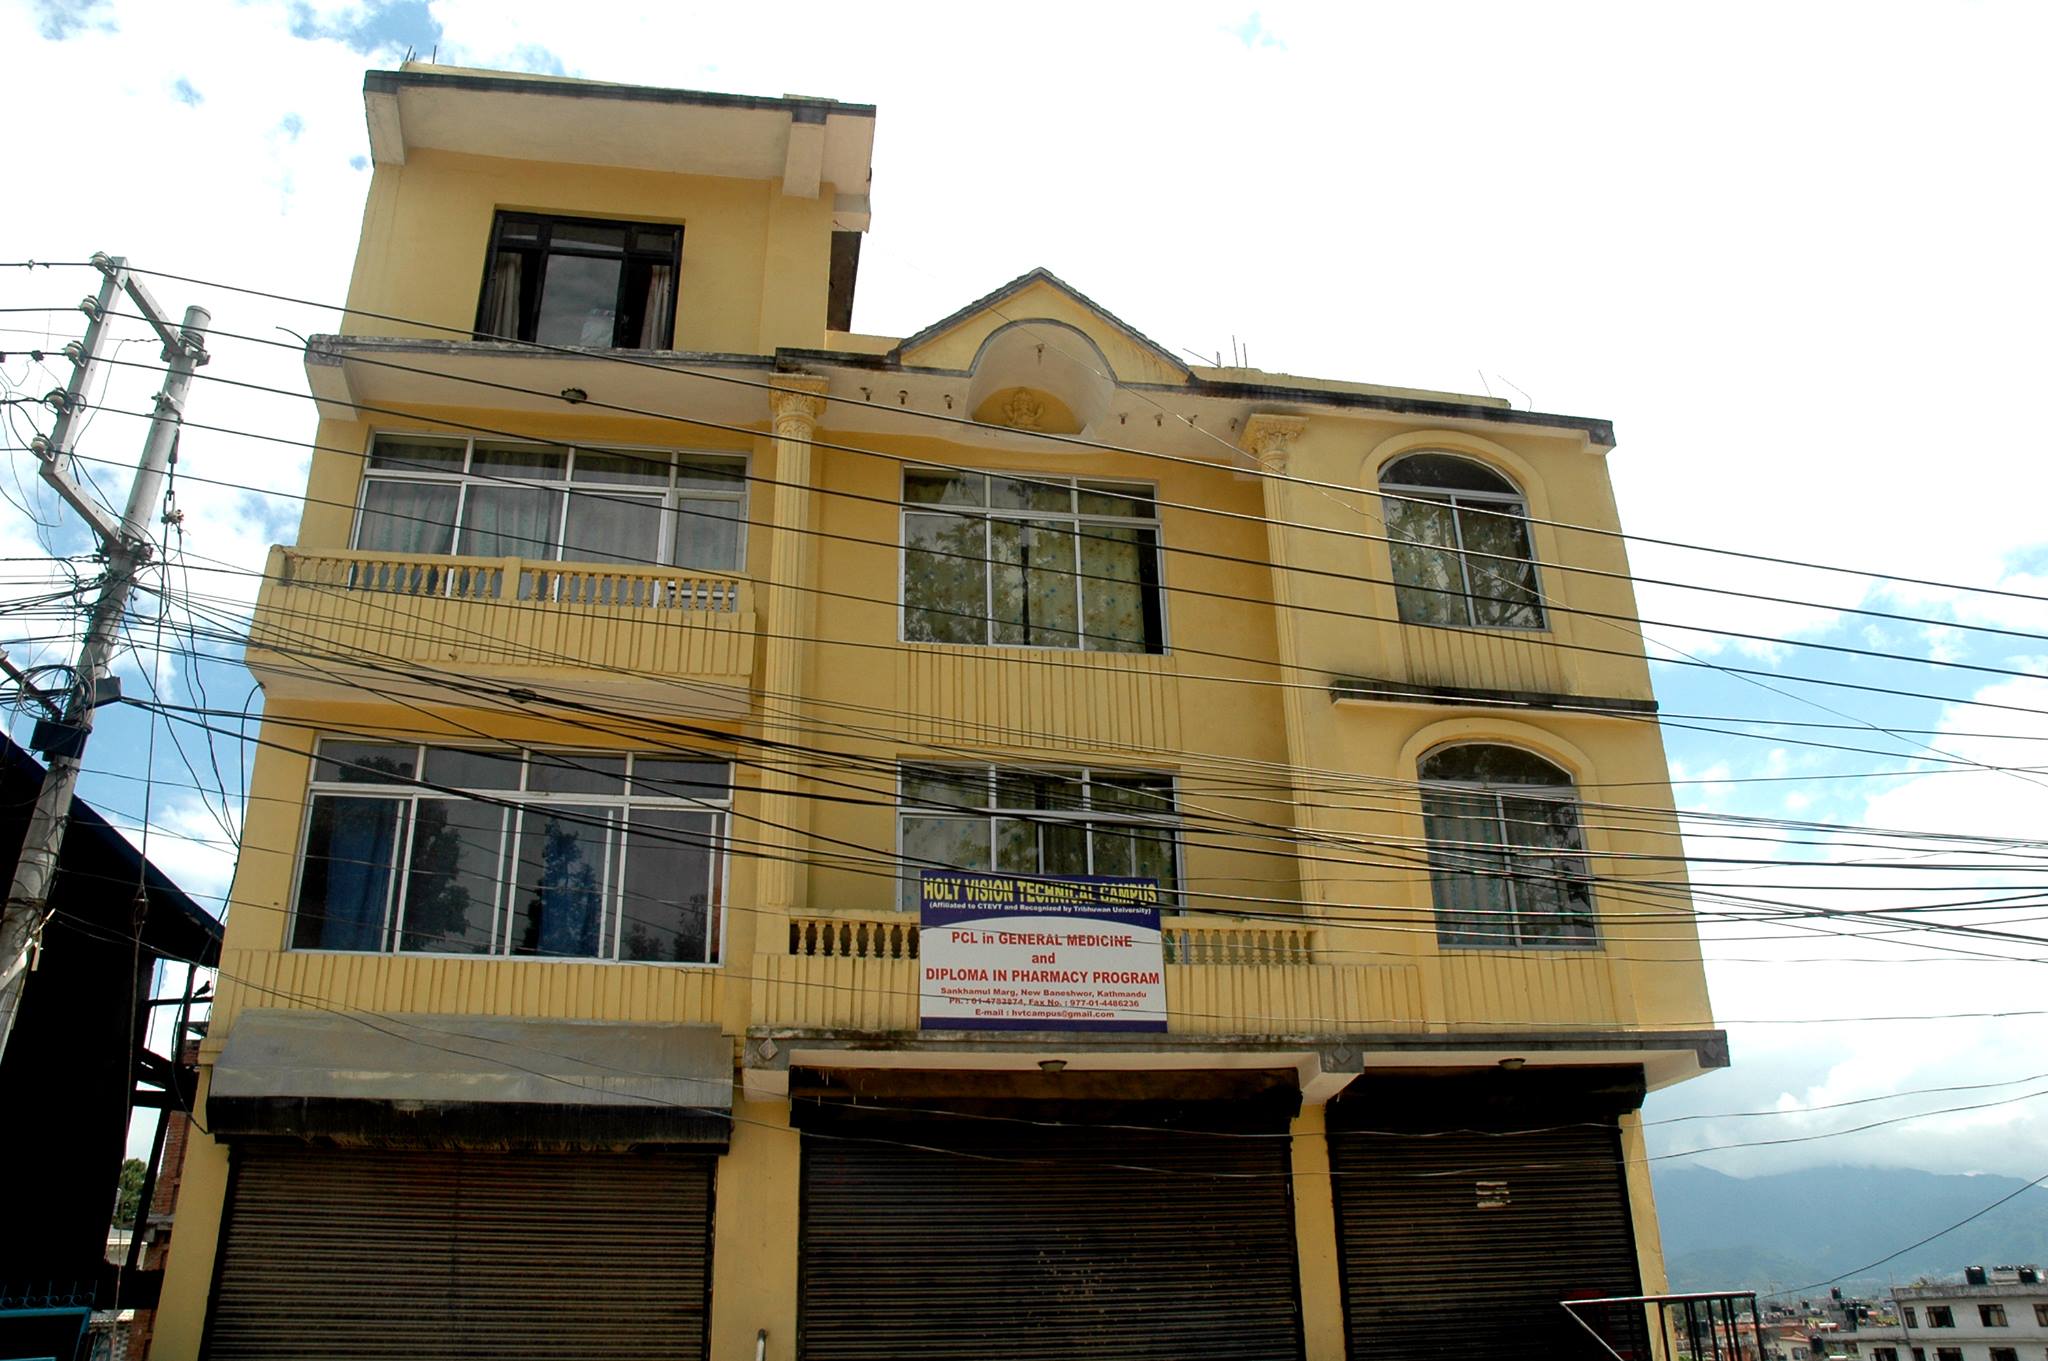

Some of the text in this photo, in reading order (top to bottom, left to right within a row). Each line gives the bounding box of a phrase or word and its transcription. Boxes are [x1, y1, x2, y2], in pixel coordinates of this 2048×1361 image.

[924, 878, 1157, 905] HOLY VISION TECHNICAL CAMPUS
[929, 901, 966, 910] (Affiliated
[1063, 905, 1072, 913] by
[1112, 906, 1152, 914] University)
[952, 932, 1132, 948] PCL in GENERAL MEDICINE
[1032, 952, 1056, 964] and
[926, 968, 1160, 984] DIPLOMA IN PHARMACY PROGRAM
[940, 987, 990, 995] Sankhamul
[993, 988, 1018, 996] Marg,
[1043, 989, 1095, 998] Baneshwor,
